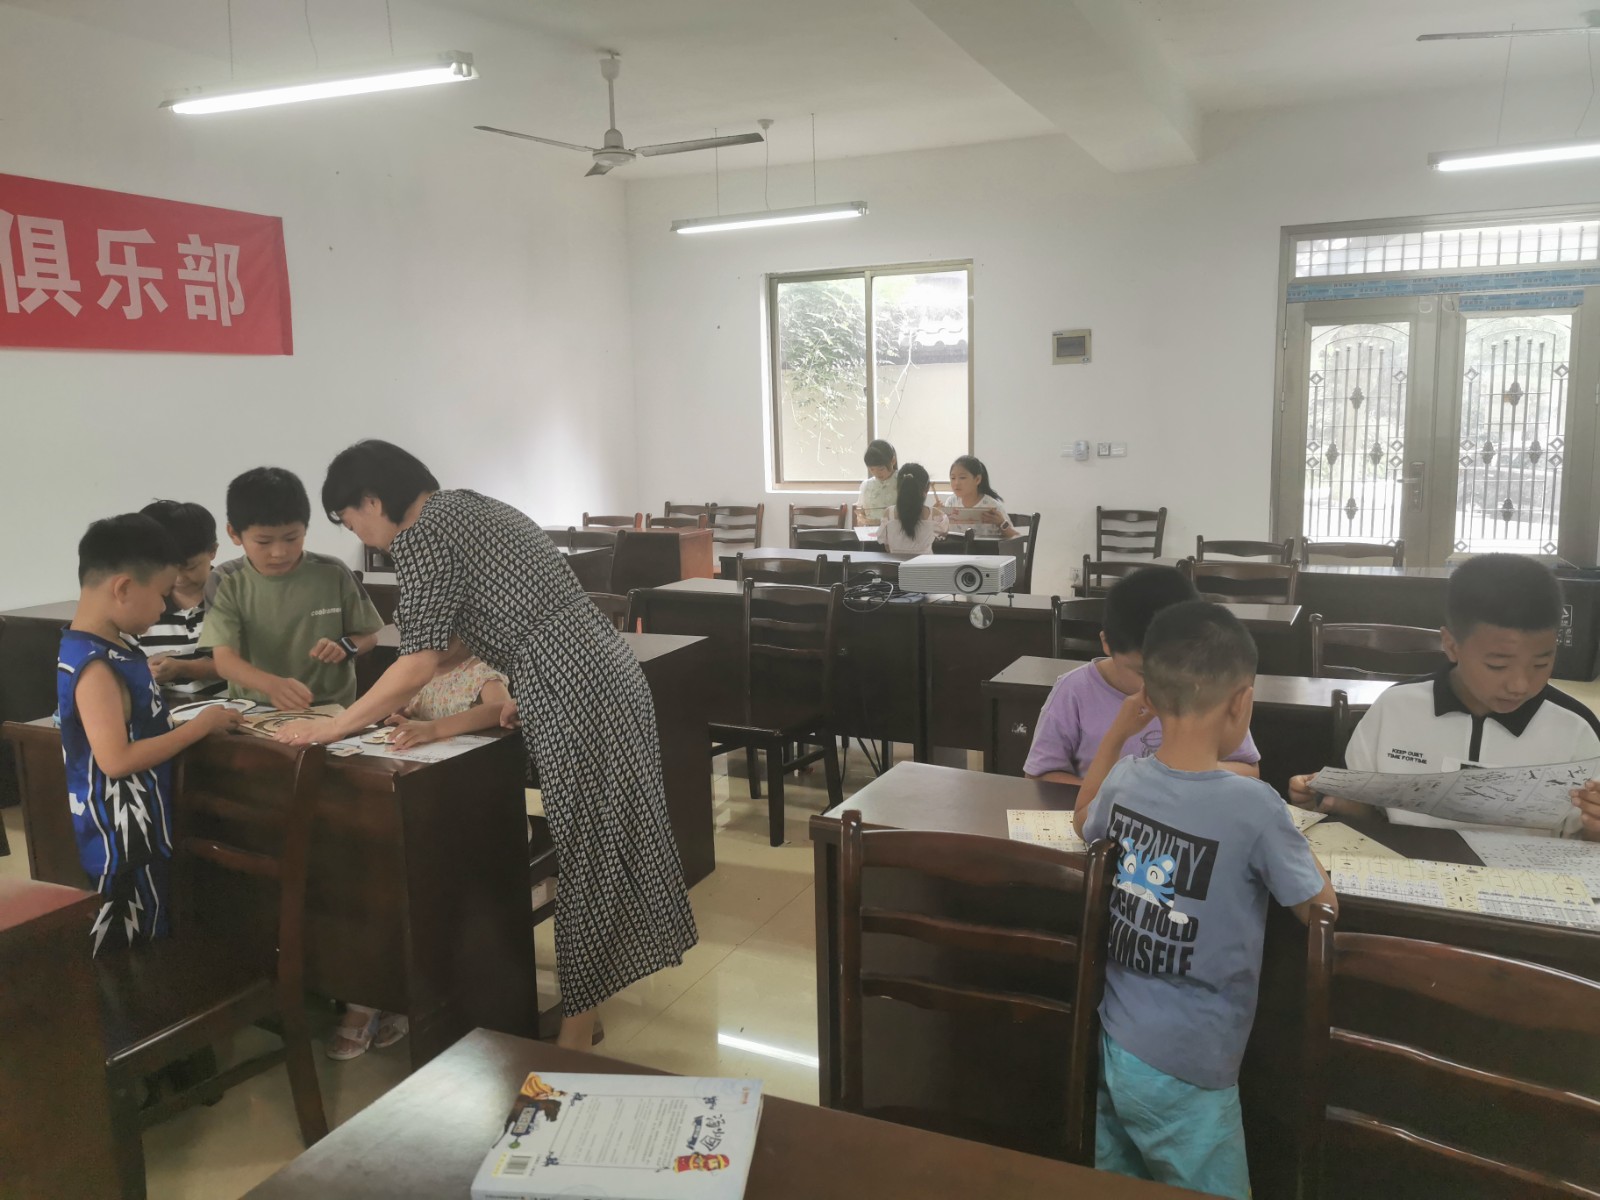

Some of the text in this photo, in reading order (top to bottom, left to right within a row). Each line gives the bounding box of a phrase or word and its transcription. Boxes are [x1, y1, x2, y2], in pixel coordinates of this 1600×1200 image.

[0, 209, 245, 327] 俱乐部
[1140, 903, 1199, 943] HOLD
